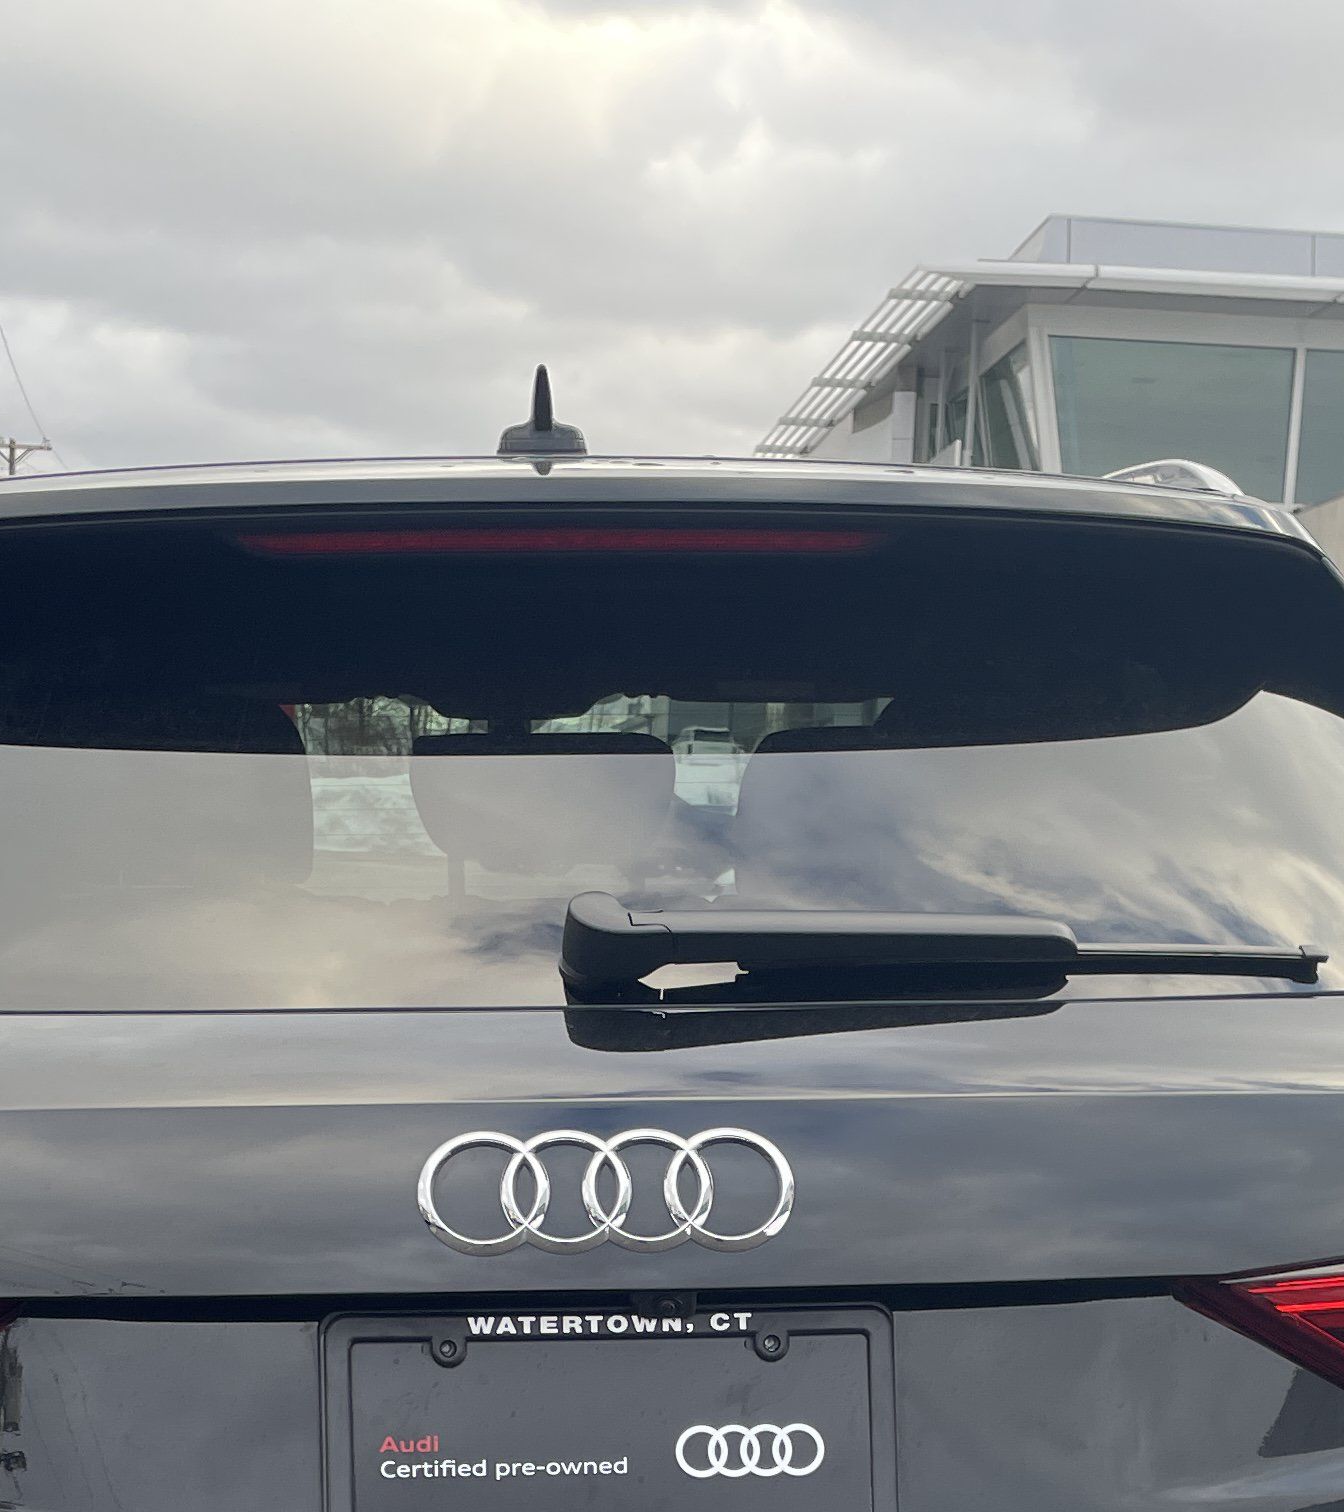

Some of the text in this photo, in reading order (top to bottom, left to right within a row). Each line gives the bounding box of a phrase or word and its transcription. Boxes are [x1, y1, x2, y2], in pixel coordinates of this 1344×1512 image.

[467, 1312, 753, 1335] WATERTOWN, CT
[379, 1434, 439, 1453] Audi
[380, 1456, 629, 1481] Certified pre-owned
